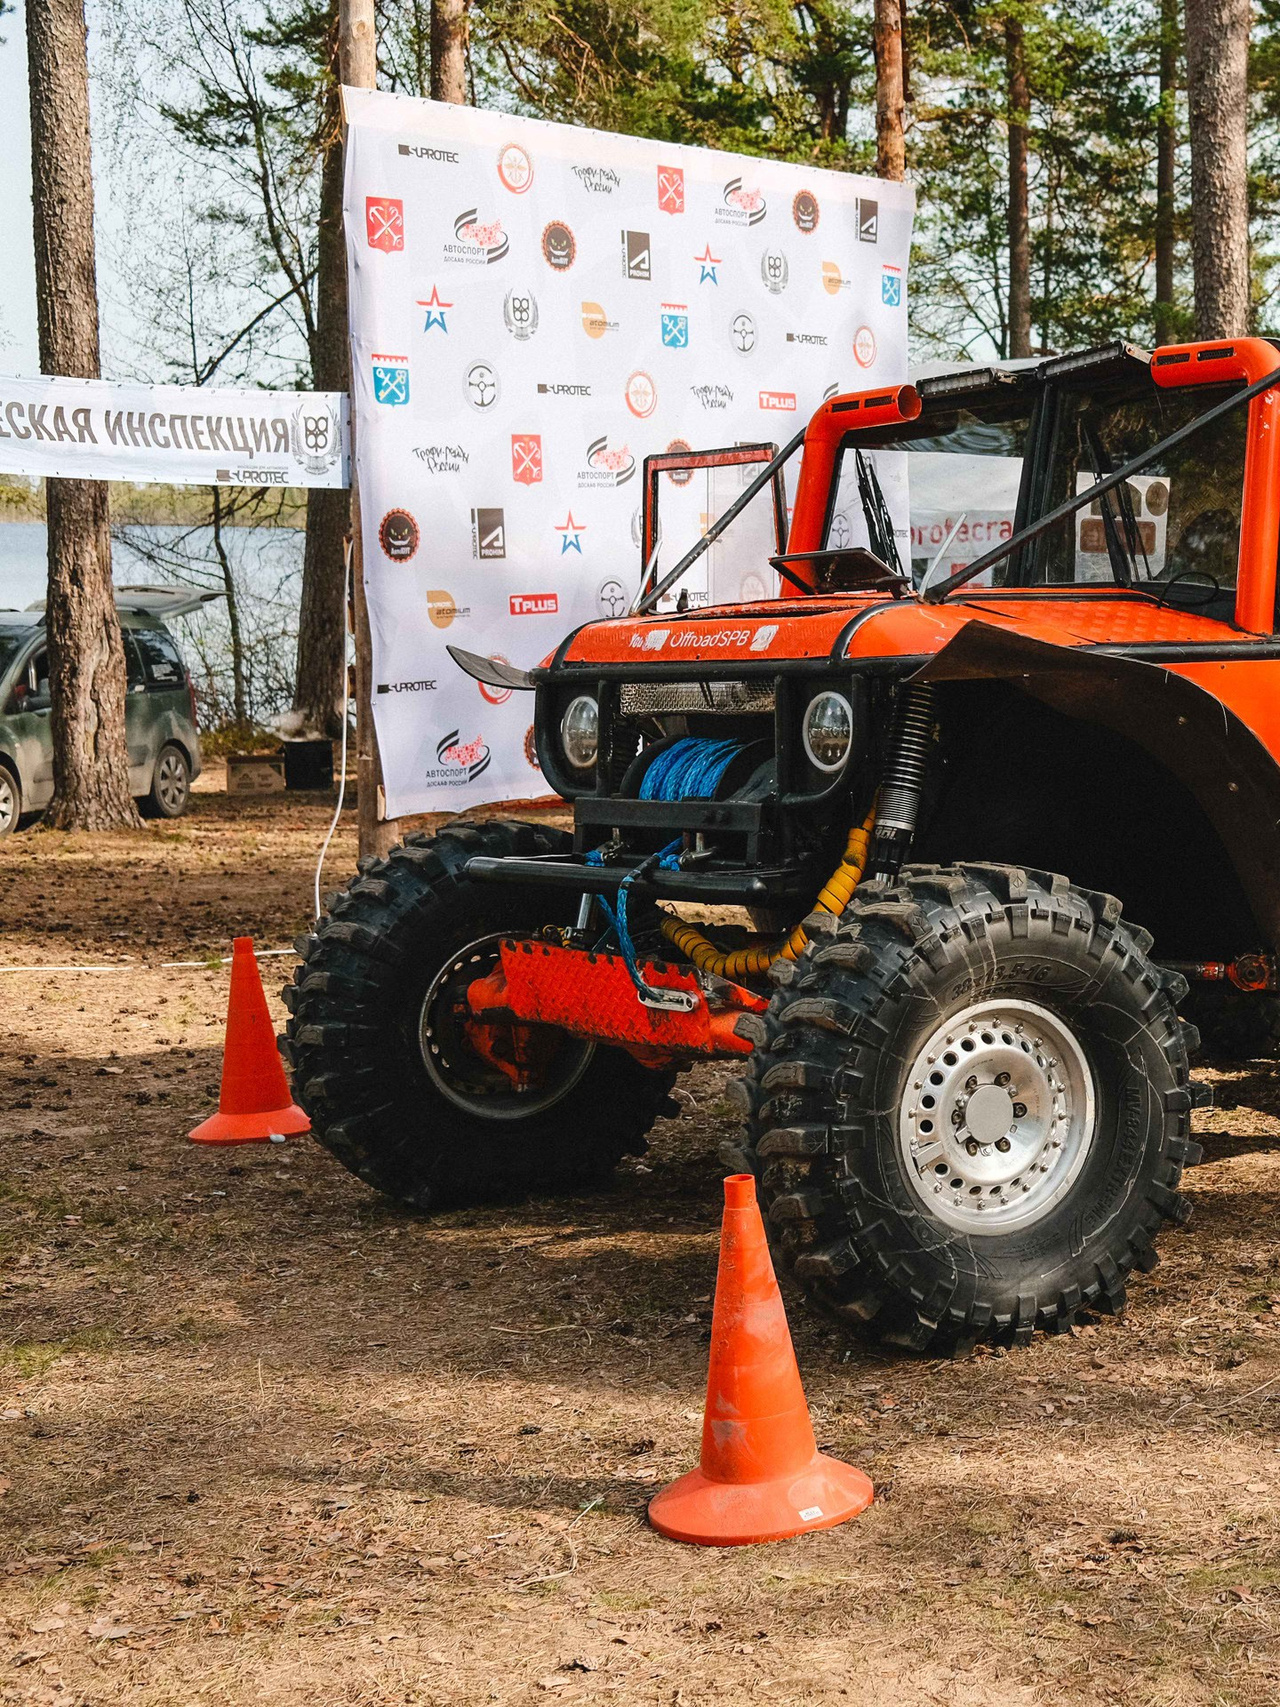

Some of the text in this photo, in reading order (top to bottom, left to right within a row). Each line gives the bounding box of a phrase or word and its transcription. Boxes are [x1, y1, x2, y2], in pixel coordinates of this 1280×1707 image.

[408, 146, 459, 164] SUPROTEC
[714, 208, 748, 219] АВТОСПОРТ
[443, 244, 486, 256] АВТОСПОРТ
[589, 319, 620, 328] atomium
[546, 384, 592, 396] SUPROTEC
[760, 394, 795, 409] TPLUS
[104, 410, 290, 460] ИНСПЕКЦИЯ
[230, 470, 290, 484] SUPROTEC
[577, 471, 615, 480] АВТОСПОРТ
[481, 549, 504, 557] PROHIM
[511, 597, 558, 613] TPLUS
[436, 607, 471, 616] atomium
[389, 680, 437, 693] SUPROTEC
[426, 767, 467, 779] АВТОСПОРТ
